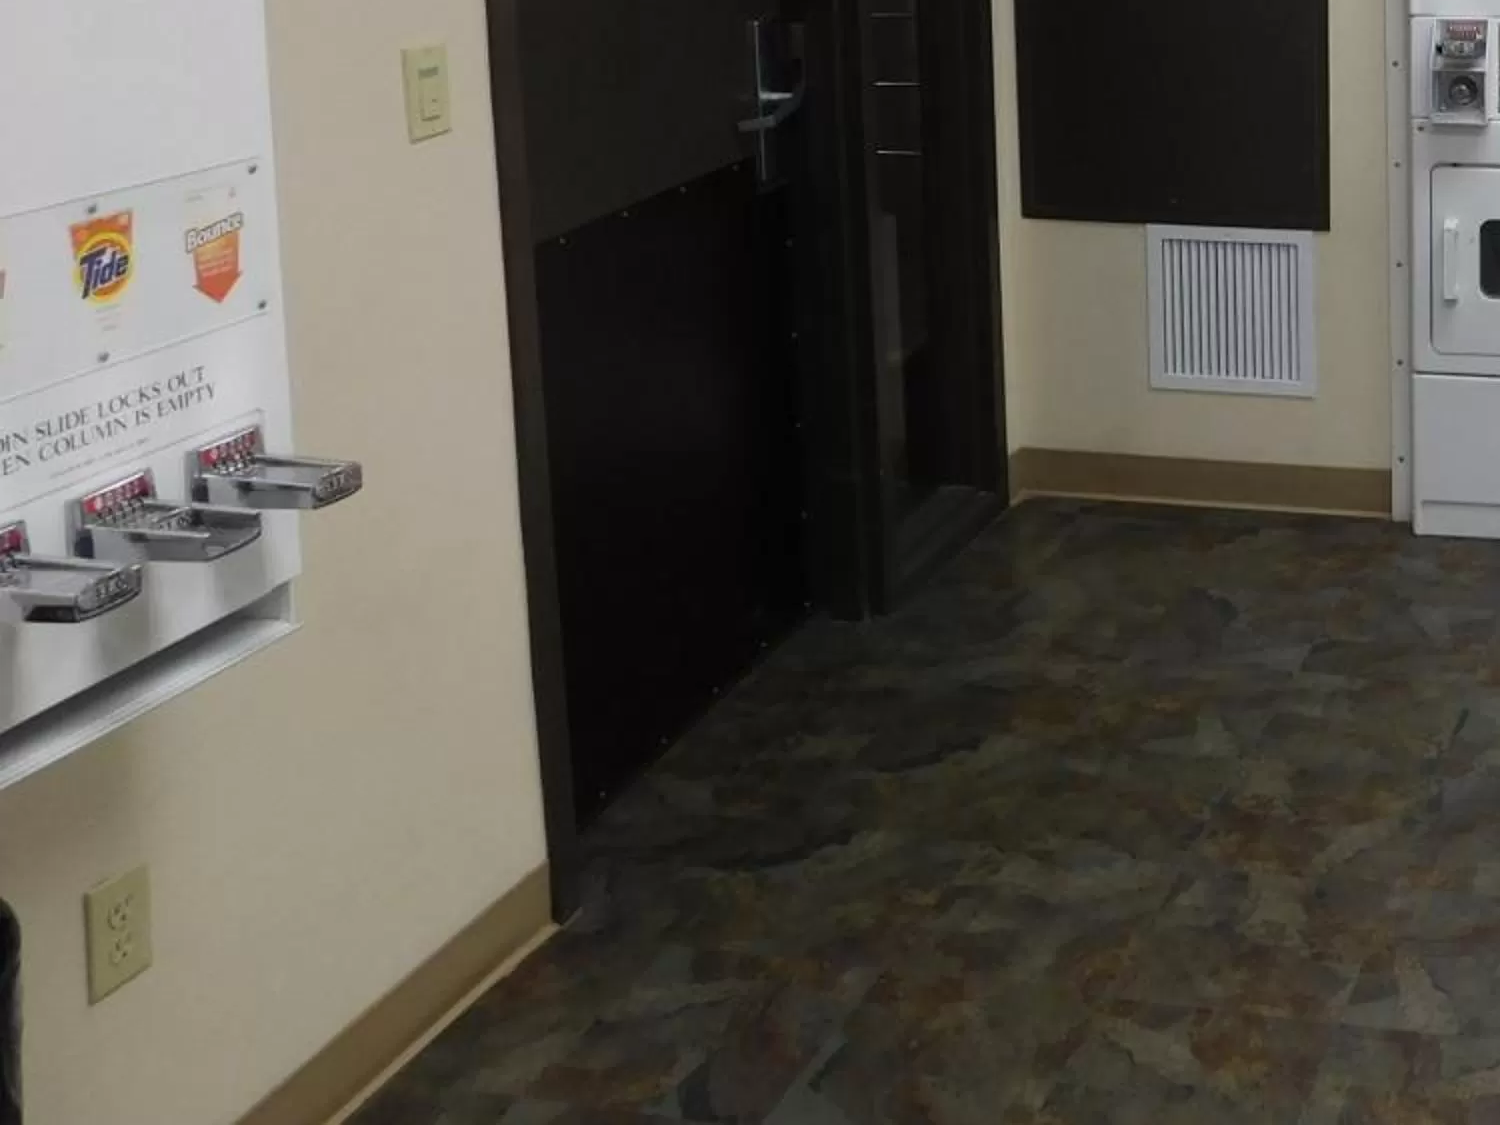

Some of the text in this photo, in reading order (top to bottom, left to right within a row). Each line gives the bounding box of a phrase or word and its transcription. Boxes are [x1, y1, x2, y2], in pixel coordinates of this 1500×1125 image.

[79, 246, 129, 300] Tide
[35, 408, 92, 441] SLIDE
[97, 382, 162, 419] LOCKS
[167, 366, 205, 394] OUT
[38, 417, 128, 462] COLUMN
[134, 409, 151, 426] IS
[157, 382, 216, 419] EMPTY
